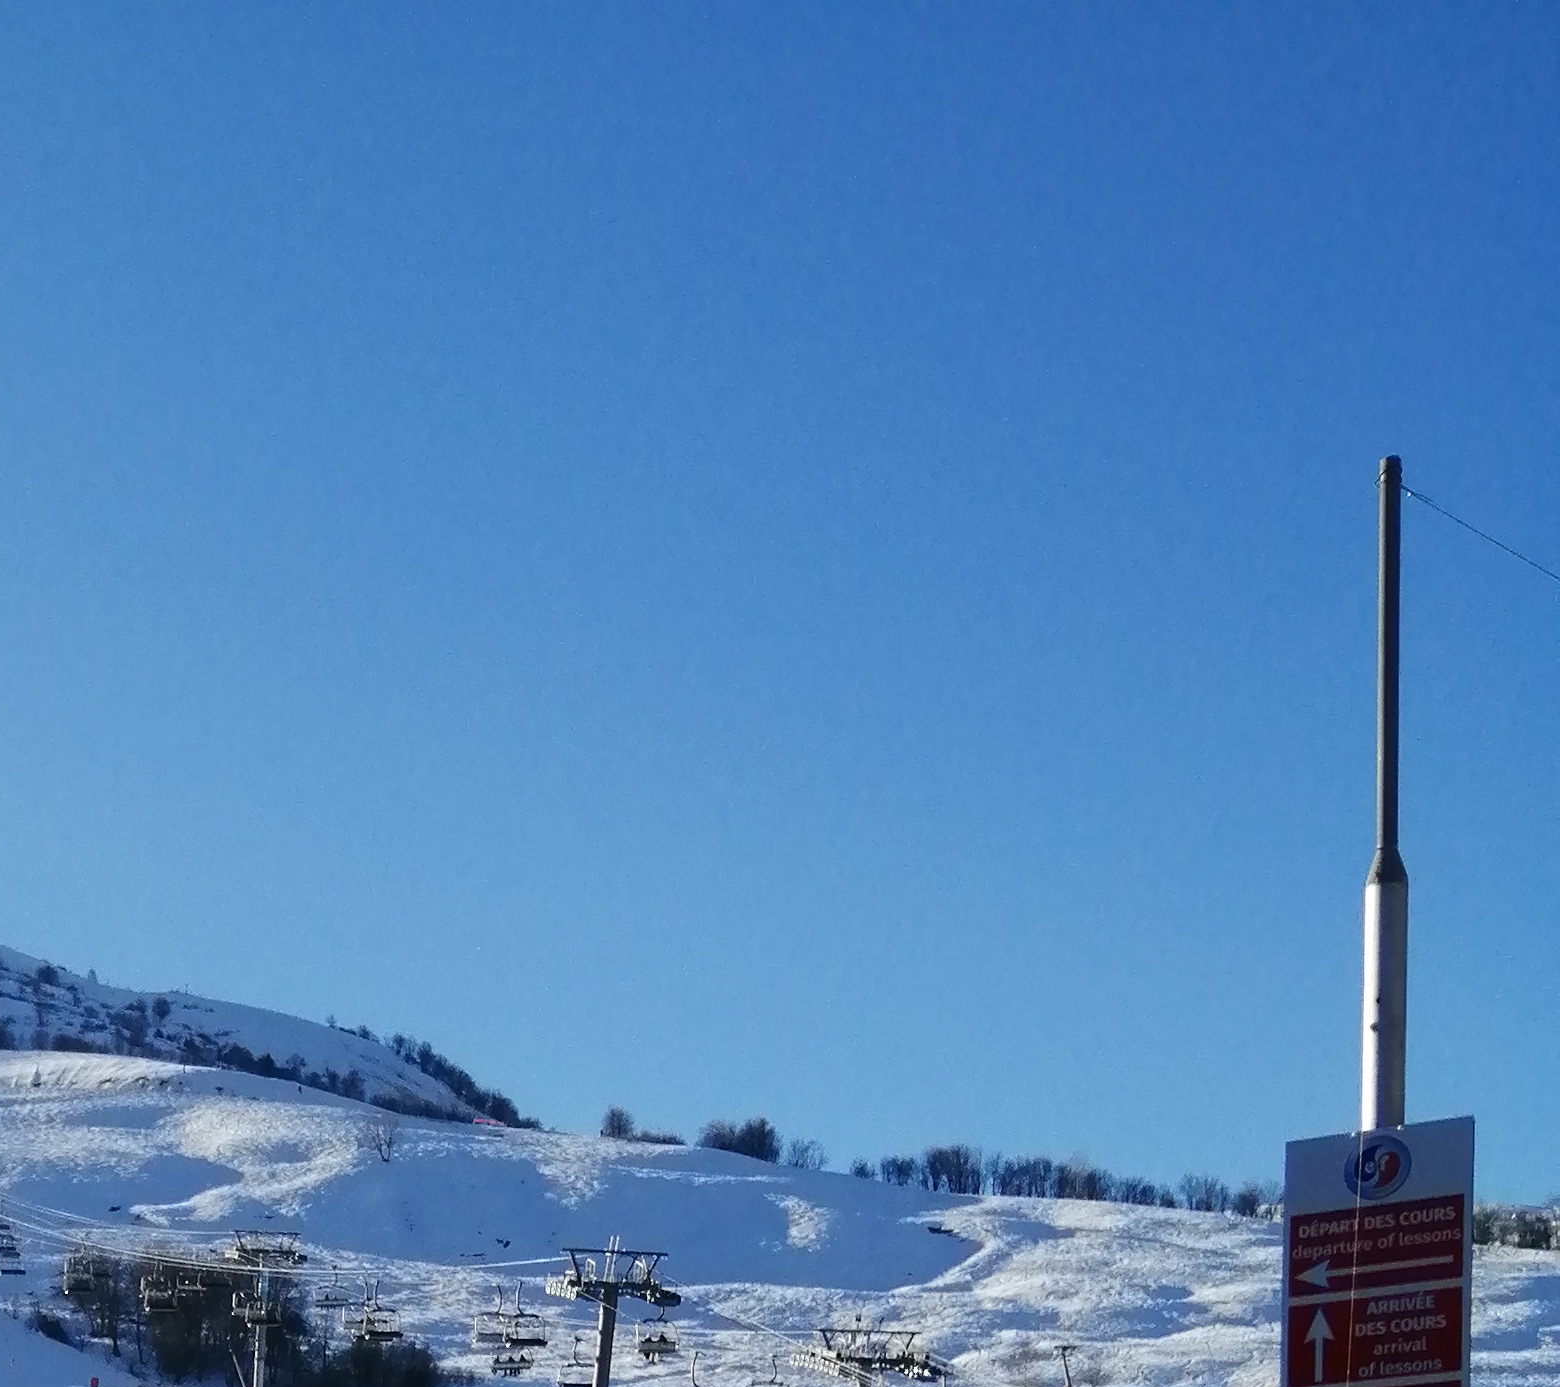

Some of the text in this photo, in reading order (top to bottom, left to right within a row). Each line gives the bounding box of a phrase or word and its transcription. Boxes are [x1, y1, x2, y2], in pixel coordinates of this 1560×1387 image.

[1298, 1205, 1457, 1239] DÉPART DES COURS
[1292, 1227, 1462, 1261] departure of lessons
[1366, 1291, 1436, 1316] ARRIVÉE
[1354, 1313, 1448, 1337] DES COURS
[1372, 1335, 1428, 1356] arrival
[1357, 1357, 1443, 1378] of lessons
